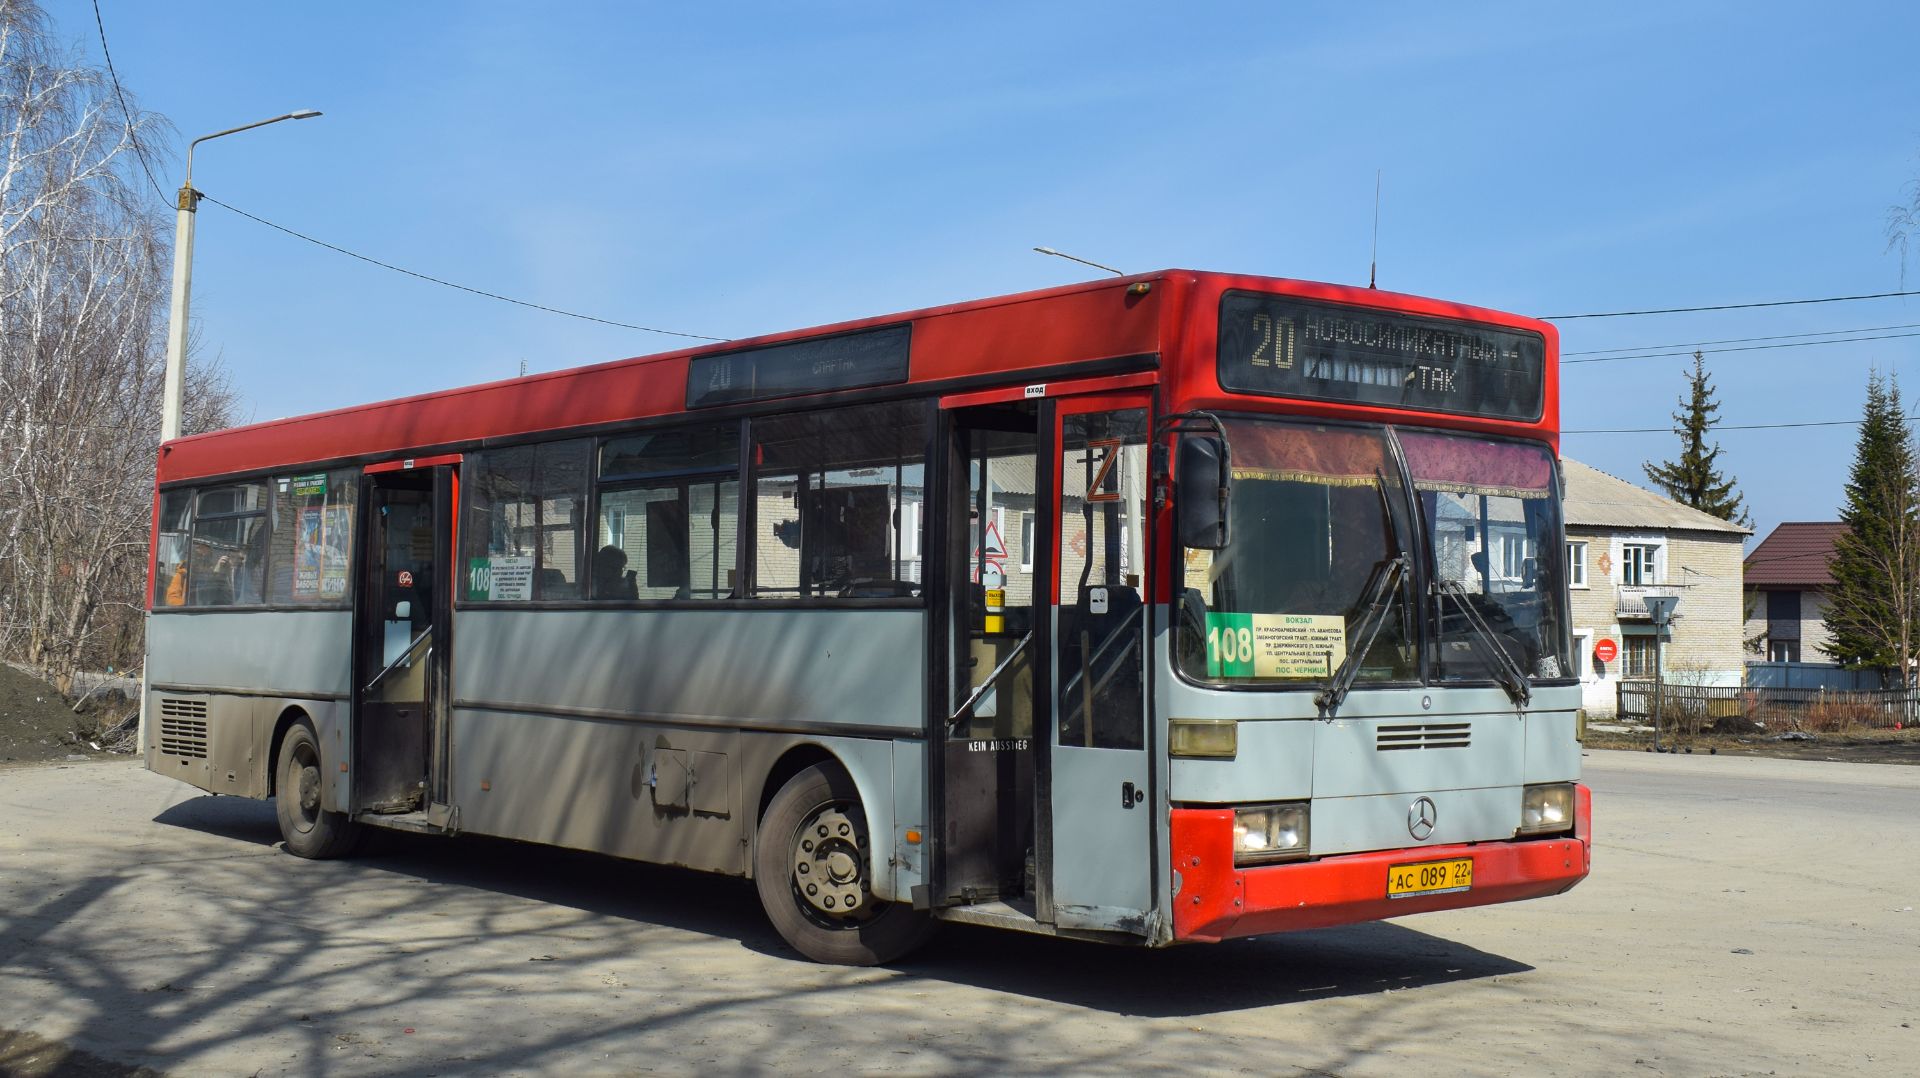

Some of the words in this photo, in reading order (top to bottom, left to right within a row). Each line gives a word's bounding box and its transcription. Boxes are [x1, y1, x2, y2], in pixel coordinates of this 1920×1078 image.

[1251, 313, 1295, 369] 20
[709, 360, 732, 390] 20
[470, 567, 490, 591] 108
[1285, 616, 1313, 624] ВОКЗАЛ
[1208, 626, 1253, 663] 108
[968, 740, 986, 751] KEIN
[990, 739, 1028, 751] AUSSTIEG
[1420, 866, 1447, 887] 089
[1454, 863, 1468, 878] 22
